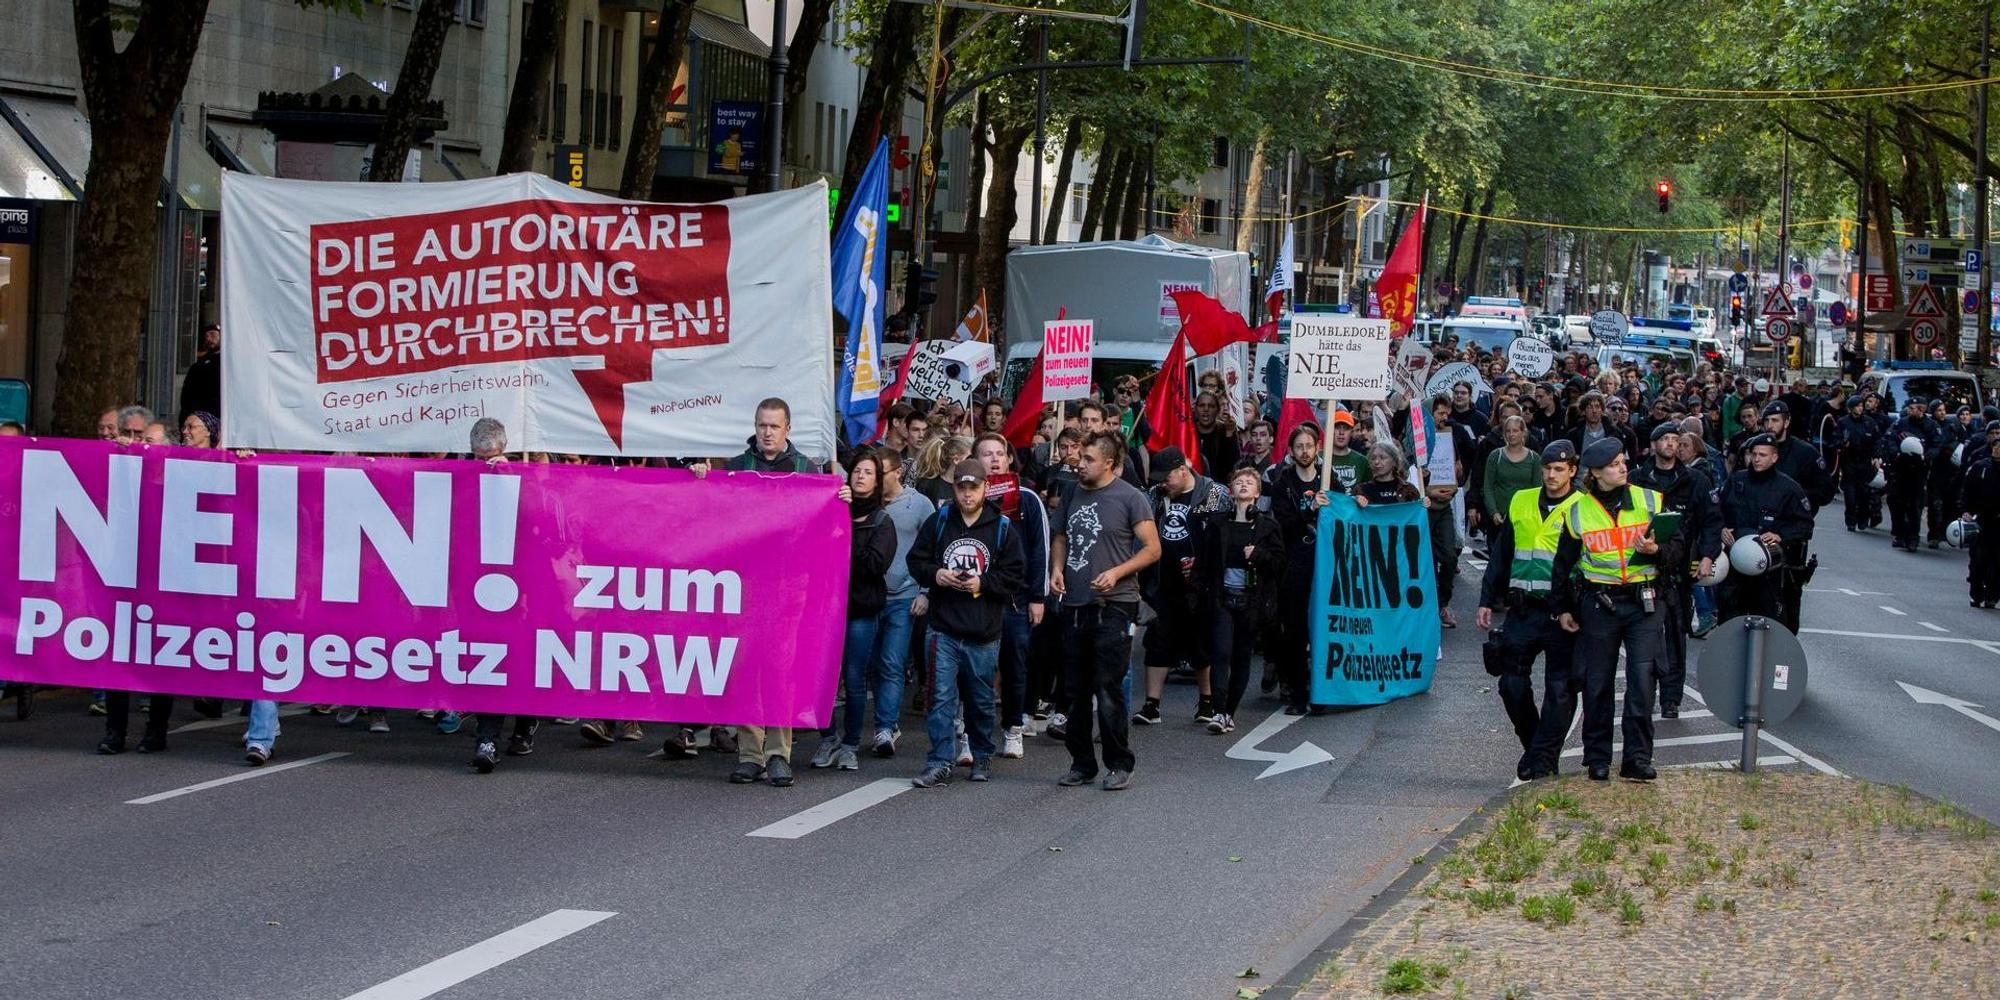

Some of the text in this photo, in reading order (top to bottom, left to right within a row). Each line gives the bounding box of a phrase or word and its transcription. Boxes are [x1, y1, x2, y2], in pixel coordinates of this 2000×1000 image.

[717, 107, 757, 119] best way
[717, 117, 747, 128] to stay
[0, 210, 28, 224] ping
[316, 206, 704, 277] DIE AUTORITÄRE
[318, 260, 639, 322] FORMIERUNG
[320, 295, 727, 371] DURCHBRECHEN!
[1046, 325, 1091, 355] NEIN!
[1294, 322, 1387, 341] DUMBLEDORE
[1771, 323, 1786, 336] 30
[1916, 326, 1933, 340] 30
[925, 339, 945, 355] Ich
[1318, 339, 1362, 351] hätte das
[1045, 357, 1089, 371] zum neuen
[1294, 352, 1341, 375] NIE
[322, 369, 551, 411] Gegen Sicherheitswahn,
[913, 379, 937, 398] hier
[934, 375, 951, 392] ich
[1044, 374, 1089, 389] Polizeigesetz
[1311, 373, 1384, 391] zugelassen!
[649, 393, 723, 416] #NoPolGNRW
[323, 399, 486, 435] Staat und Kapital
[18, 448, 523, 614] NEIN!
[1584, 522, 1648, 551] POLIZE
[1329, 519, 1424, 610] NEIN!
[573, 565, 744, 615] zum
[15, 597, 740, 697] Polizeigesetz NRW
